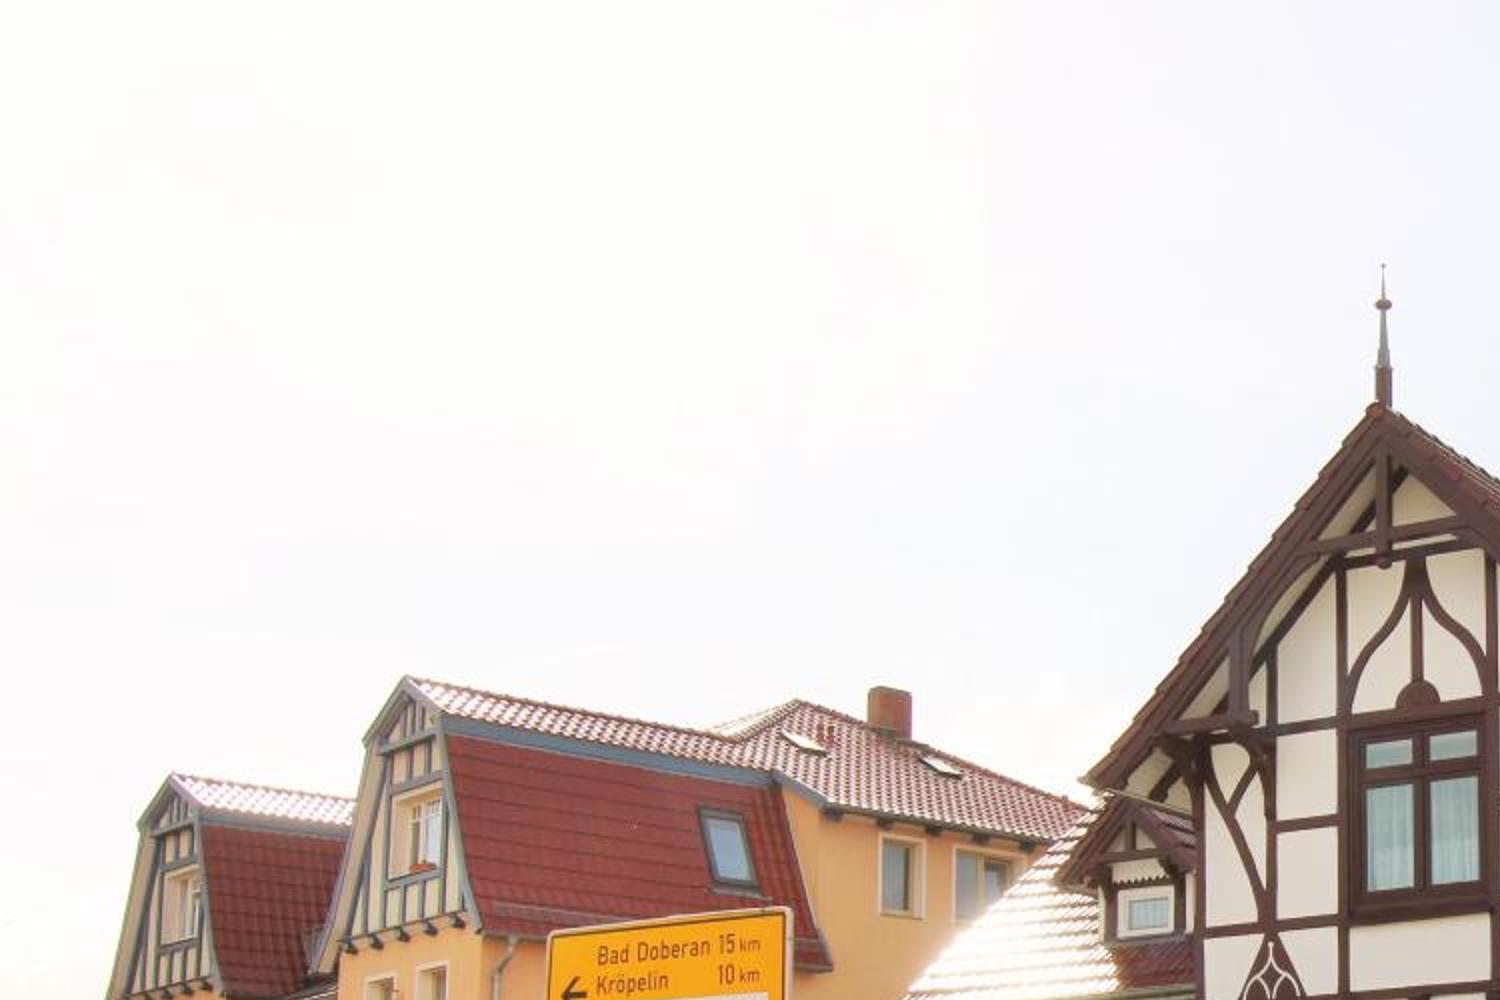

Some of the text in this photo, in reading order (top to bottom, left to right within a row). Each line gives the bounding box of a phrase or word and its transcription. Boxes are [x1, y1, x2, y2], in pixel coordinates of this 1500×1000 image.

[597, 933, 761, 966] Bad Doberan 15 km
[596, 964, 760, 997] Kröpelin 10 km
